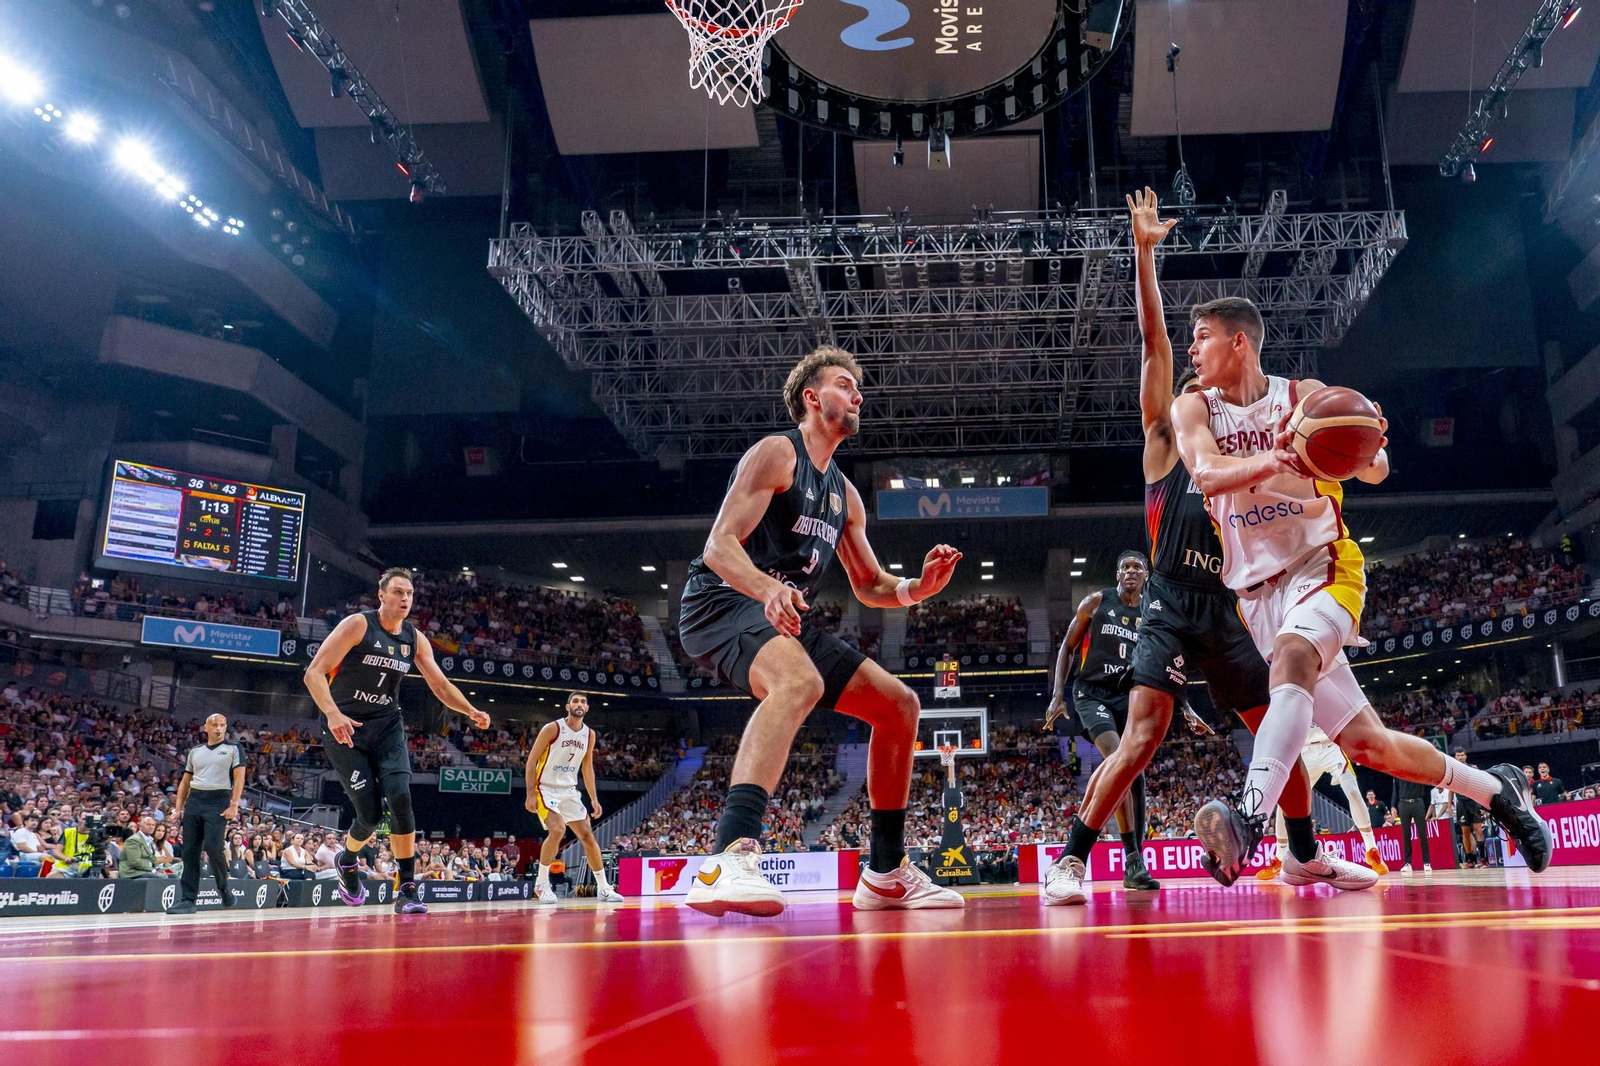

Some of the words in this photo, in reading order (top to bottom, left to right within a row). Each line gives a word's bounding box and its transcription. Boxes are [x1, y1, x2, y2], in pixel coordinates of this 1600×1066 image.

[1216, 428, 1274, 456] ESPAÑ
[188, 478, 205, 489] 36
[222, 484, 237, 494] 43
[259, 492, 302, 506] ALEMANIA
[956, 493, 1001, 505] Movistar
[200, 500, 230, 514] 1:13
[204, 528, 212, 537] 2
[183, 540, 190, 548] 5
[193, 541, 220, 551] FALTAS
[223, 545, 230, 554] 5
[802, 548, 820, 575] 3
[1183, 548, 1222, 574] ING
[210, 629, 252, 641] Movistar
[210, 638, 251, 647] ARENA
[362, 654, 411, 674] DEUTSCHLAND
[377, 672, 387, 688] 7
[942, 672, 956, 687] 15
[353, 689, 378, 704] ING
[561, 740, 585, 751] ESPAÑA
[568, 753, 575, 762] 7
[444, 769, 507, 783] SALIDA
[461, 782, 490, 792] EXIT
[793, 871, 822, 886] 2029
[935, 868, 972, 877] CaixaBank
